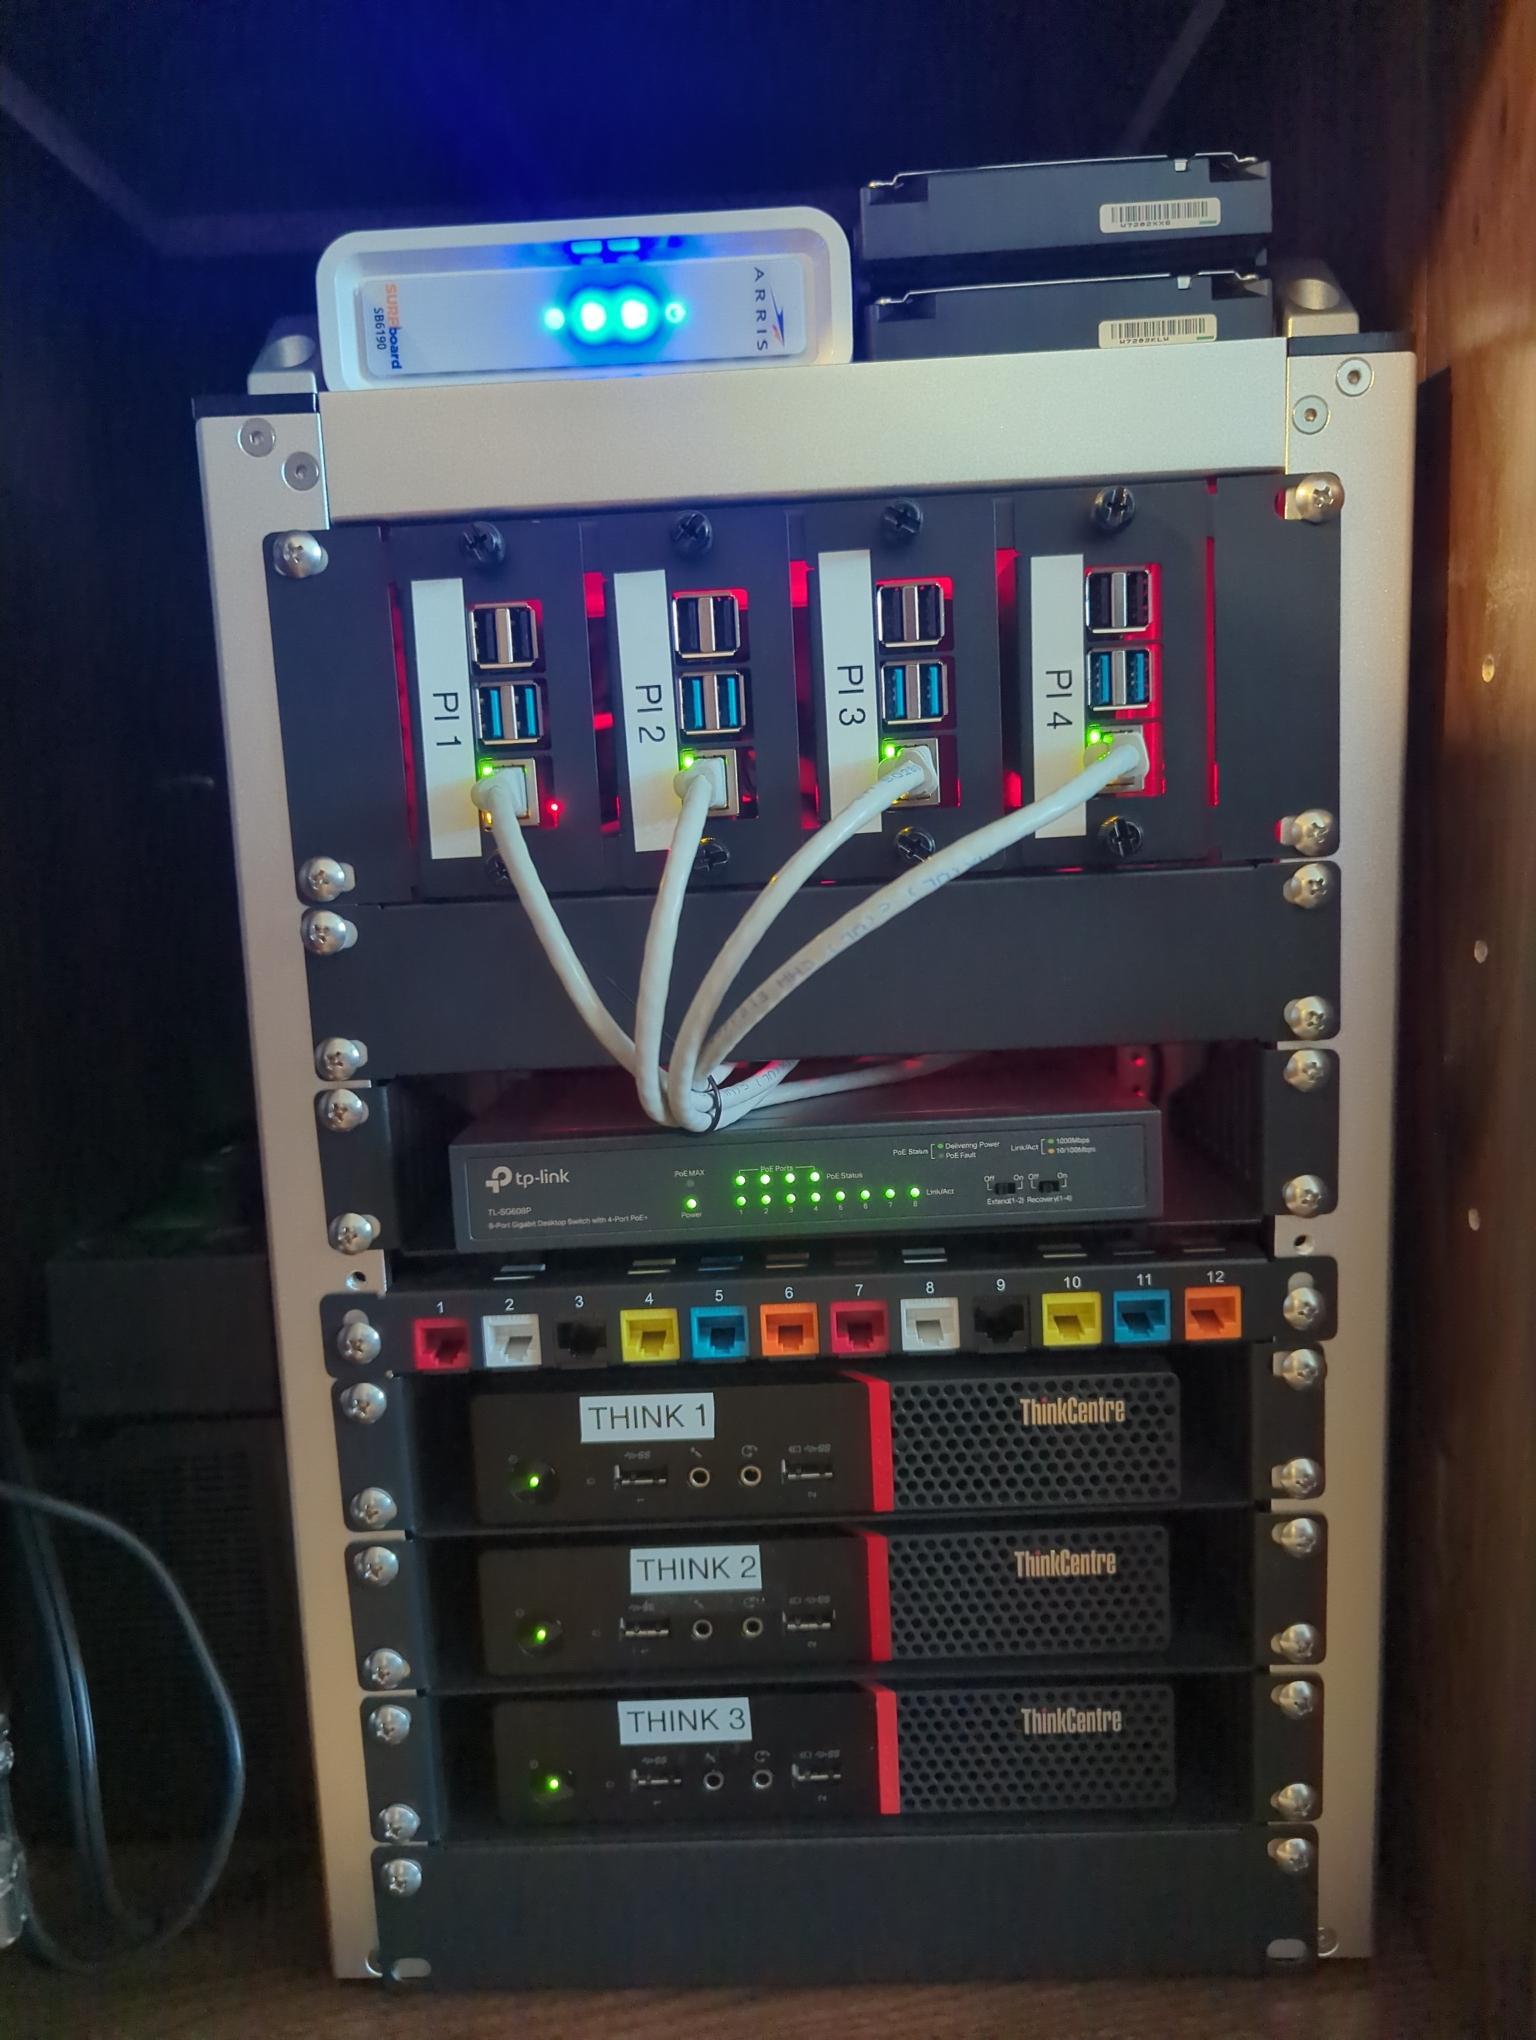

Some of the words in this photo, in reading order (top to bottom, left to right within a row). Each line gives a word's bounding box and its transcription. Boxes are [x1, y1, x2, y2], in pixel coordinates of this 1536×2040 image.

[754, 267, 768, 351] ARRIS
[373, 307, 387, 350] SB6190
[385, 283, 402, 369] SURFboard
[837, 665, 864, 694] PI
[1046, 669, 1072, 697] PI
[433, 692, 459, 720] PI
[636, 684, 662, 712] PI
[839, 707, 866, 726] 3
[1047, 711, 1073, 730] 4
[436, 735, 461, 746] 1
[639, 726, 665, 743] 2
[515, 1168, 570, 1189] tp-link
[689, 1169, 705, 1177] MAX
[630, 1213, 648, 1221] PoE+
[437, 1301, 444, 1313] 1
[505, 1299, 514, 1311] 2
[575, 1296, 584, 1308] 3
[645, 1293, 654, 1305] 4
[715, 1290, 724, 1302] 5
[785, 1287, 793, 1299] 6
[855, 1284, 863, 1297] 7
[926, 1282, 934, 1294] 8
[996, 1279, 1005, 1291] 9
[1064, 1276, 1081, 1289] 10
[1136, 1273, 1152, 1286] 11
[1206, 1271, 1224, 1283] 12
[588, 1404, 684, 1431] THINK
[695, 1403, 706, 1427] 1
[1020, 1397, 1125, 1426] ThinkCentre
[636, 1556, 730, 1582] THINK
[741, 1556, 757, 1579] 2
[1014, 1549, 1116, 1578] ThinkCentre
[626, 1708, 718, 1733] THINK
[729, 1708, 746, 1731] 3
[1021, 1707, 1122, 1735] ThinkCentre
